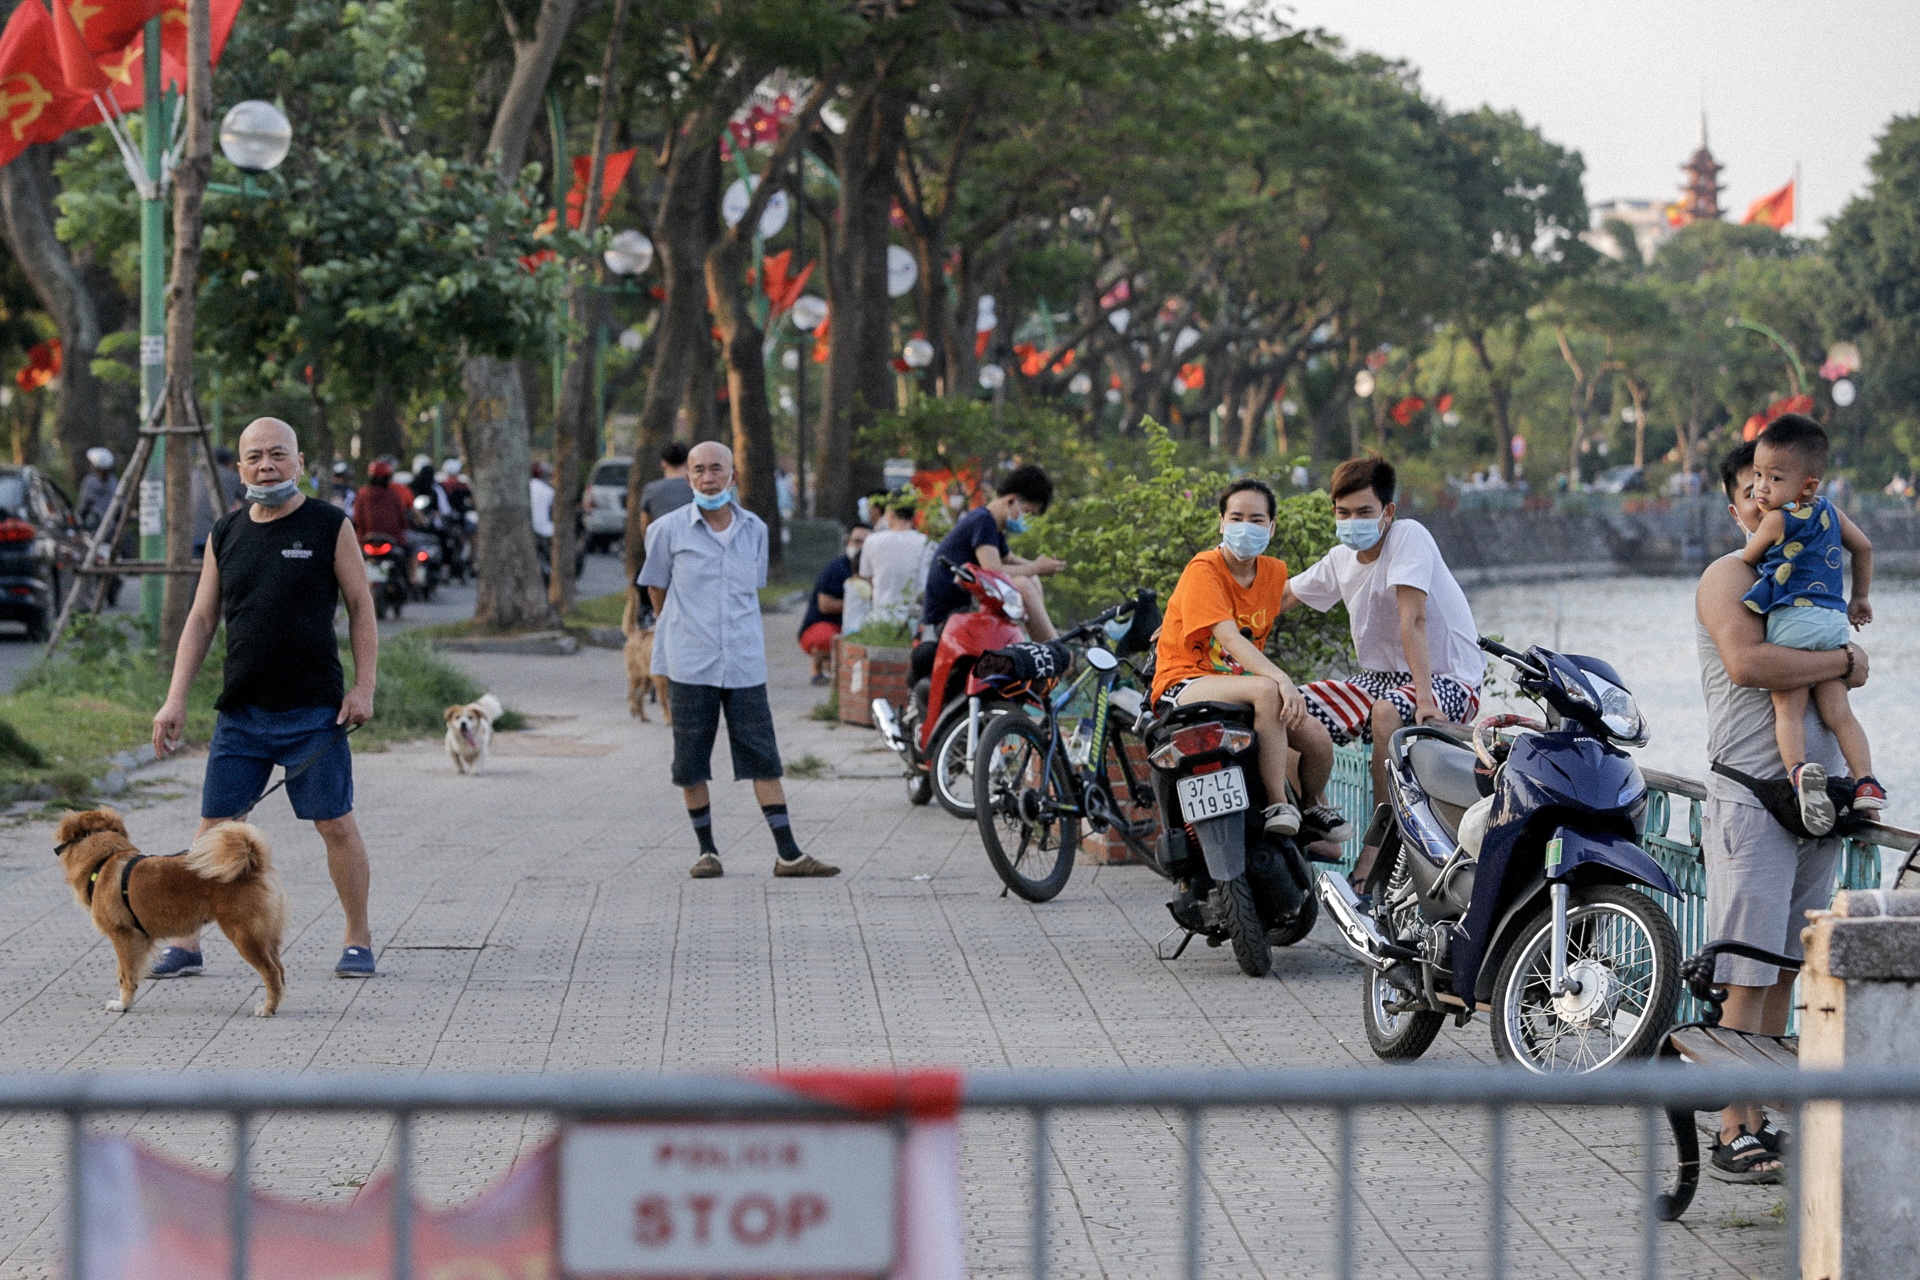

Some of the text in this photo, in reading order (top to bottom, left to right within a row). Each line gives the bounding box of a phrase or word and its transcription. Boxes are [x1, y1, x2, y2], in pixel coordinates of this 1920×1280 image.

[1187, 771, 1235, 798] 37-L2
[1187, 789, 1244, 819] 119.95
[633, 1192, 831, 1246] STOP
